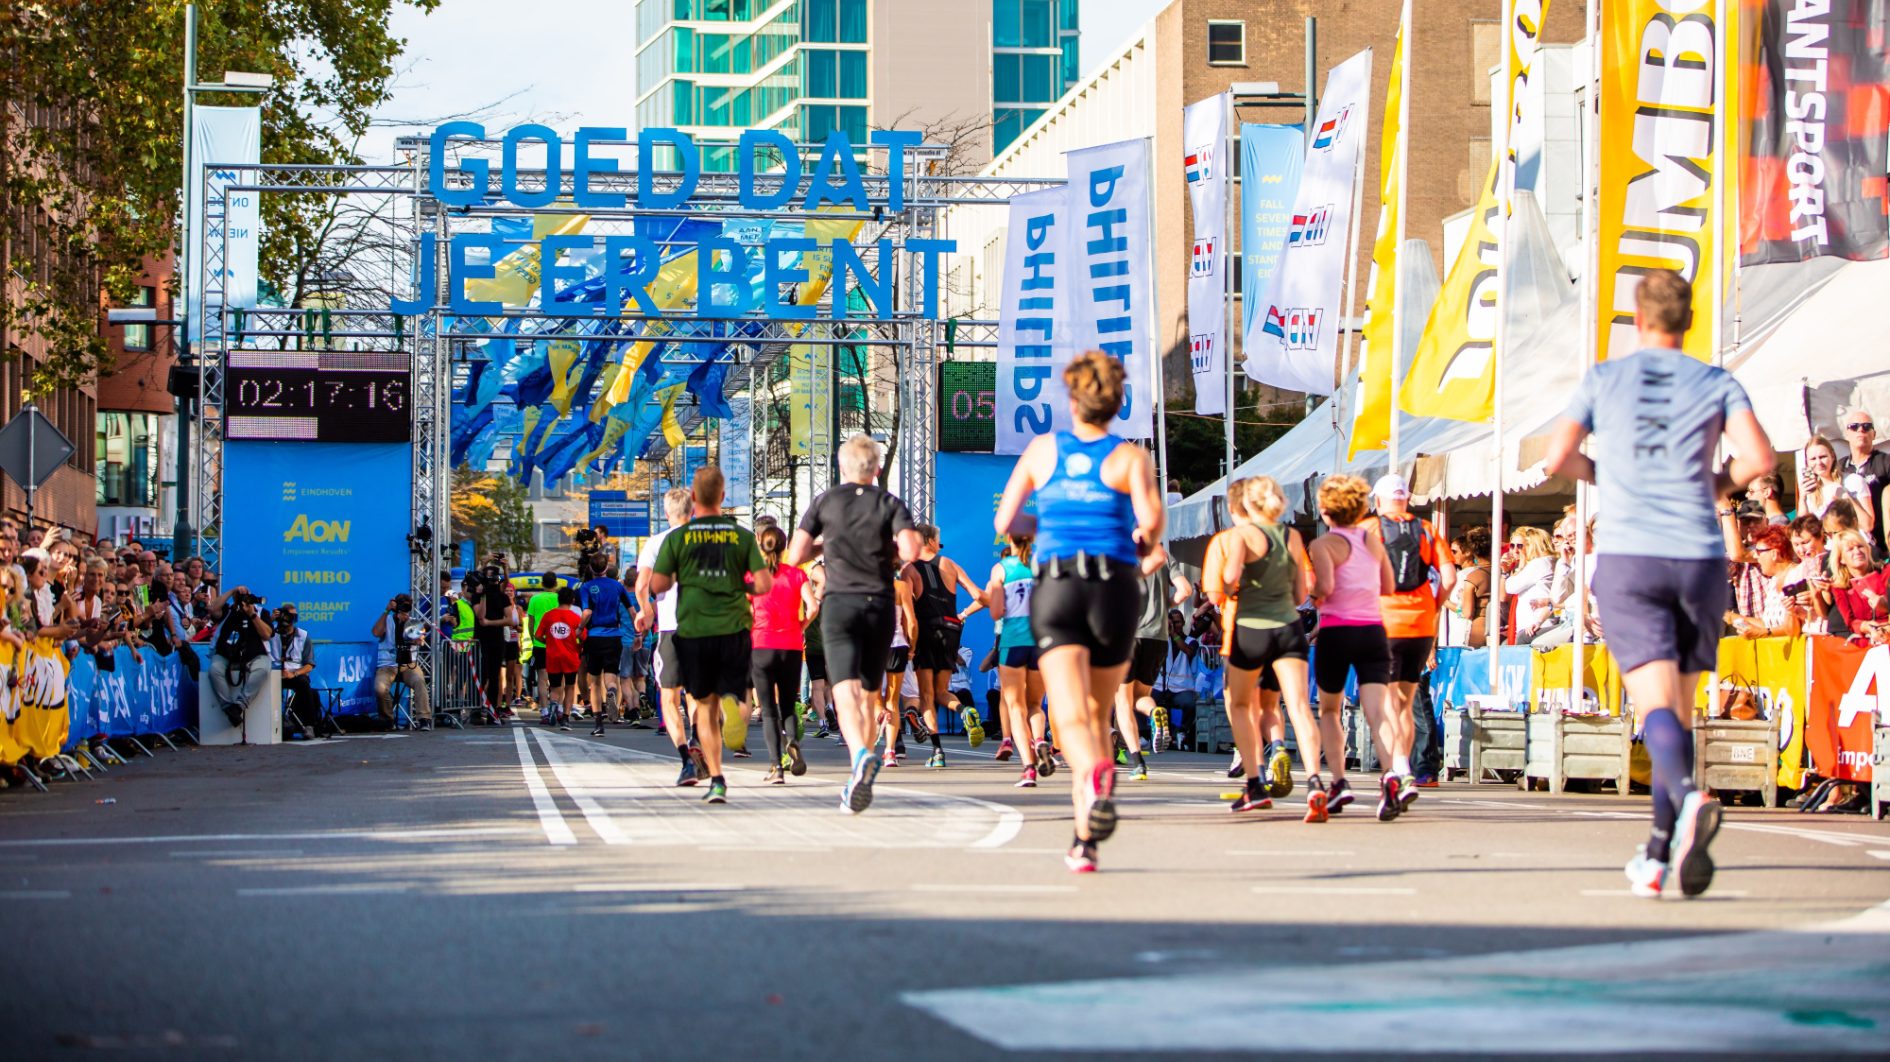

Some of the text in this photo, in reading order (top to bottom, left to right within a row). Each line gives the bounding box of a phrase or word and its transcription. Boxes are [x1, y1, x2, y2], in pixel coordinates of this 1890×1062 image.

[428, 121, 923, 212] GOED DAT
[1260, 200, 1285, 209] FALL
[1255, 213, 1290, 223] SEVEN
[391, 232, 957, 320] JE ER BENT
[239, 379, 403, 411] 02:17:16
[301, 488, 352, 496] EINDHOVEN
[283, 570, 351, 584] JUMBO
[299, 602, 350, 611] BRABANT
[299, 612, 335, 621] SPORT
[554, 626, 567, 635] NB
